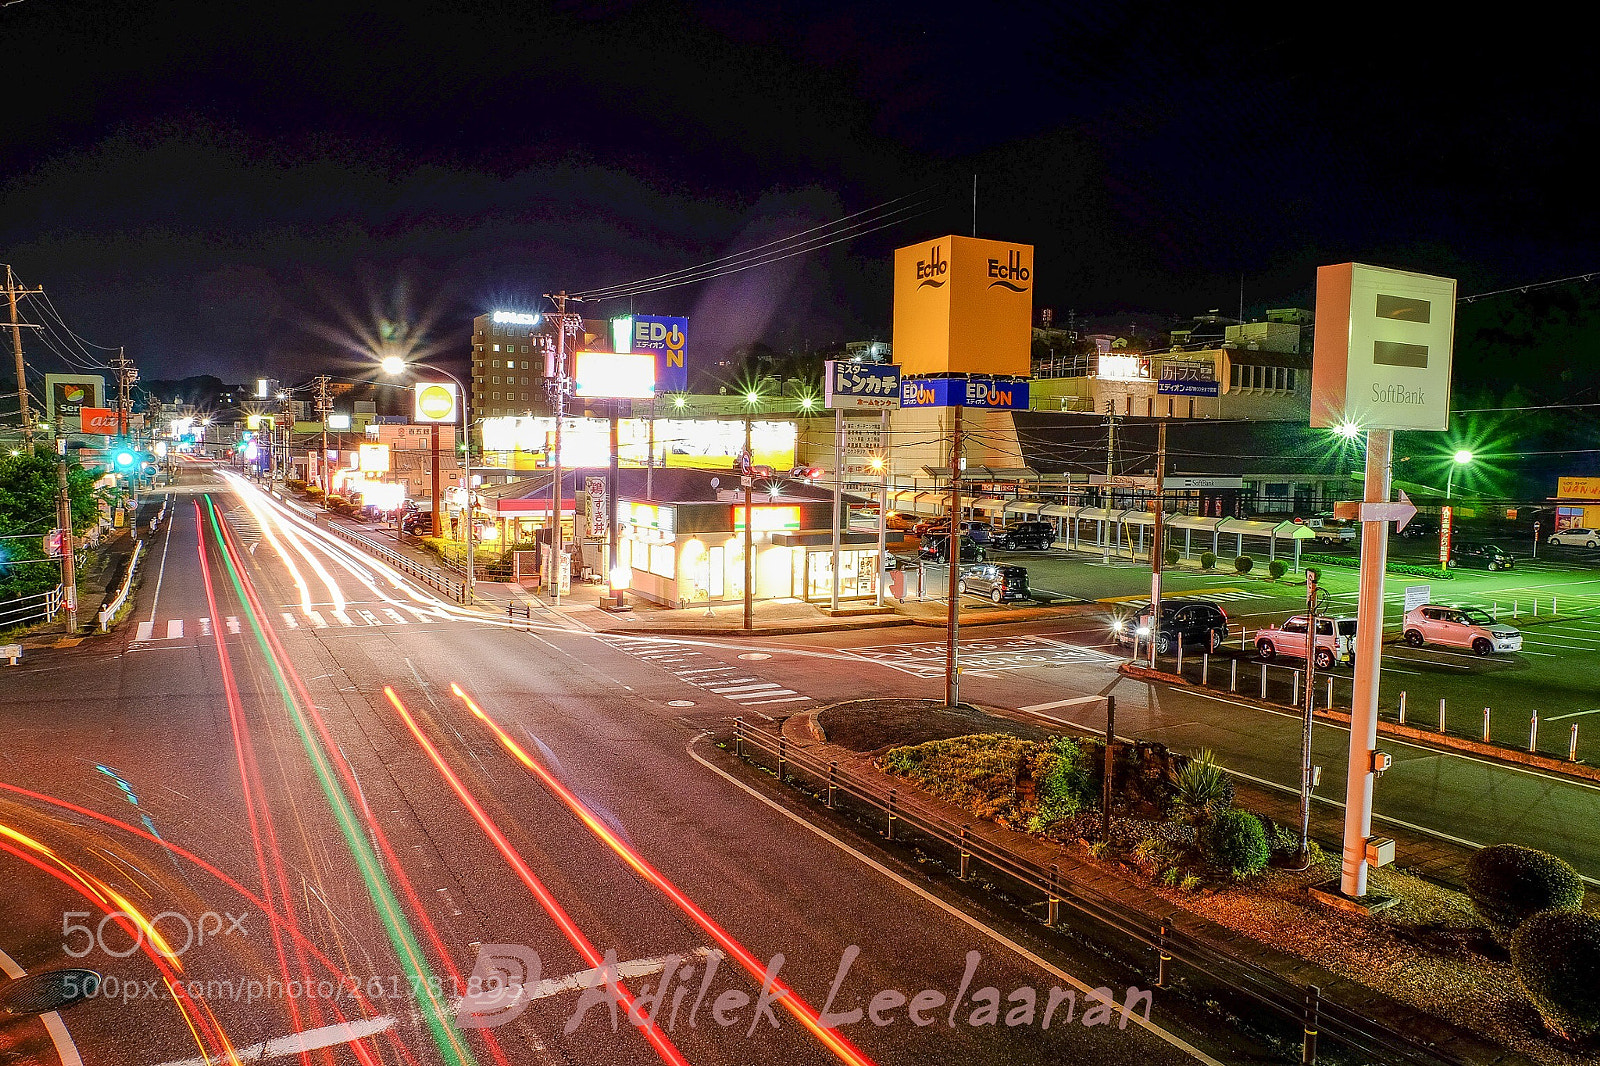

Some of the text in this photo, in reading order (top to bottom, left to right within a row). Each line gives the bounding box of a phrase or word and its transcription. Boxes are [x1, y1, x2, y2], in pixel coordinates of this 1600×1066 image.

[636, 341, 665, 349] エディオン
[837, 363, 869, 374] ミスター
[837, 373, 898, 395] トンカチ
[903, 383, 935, 405] EDION
[965, 383, 1012, 406] EDION
[1371, 382, 1425, 405] SoftBank
[857, 398, 898, 406] ホームセンター
